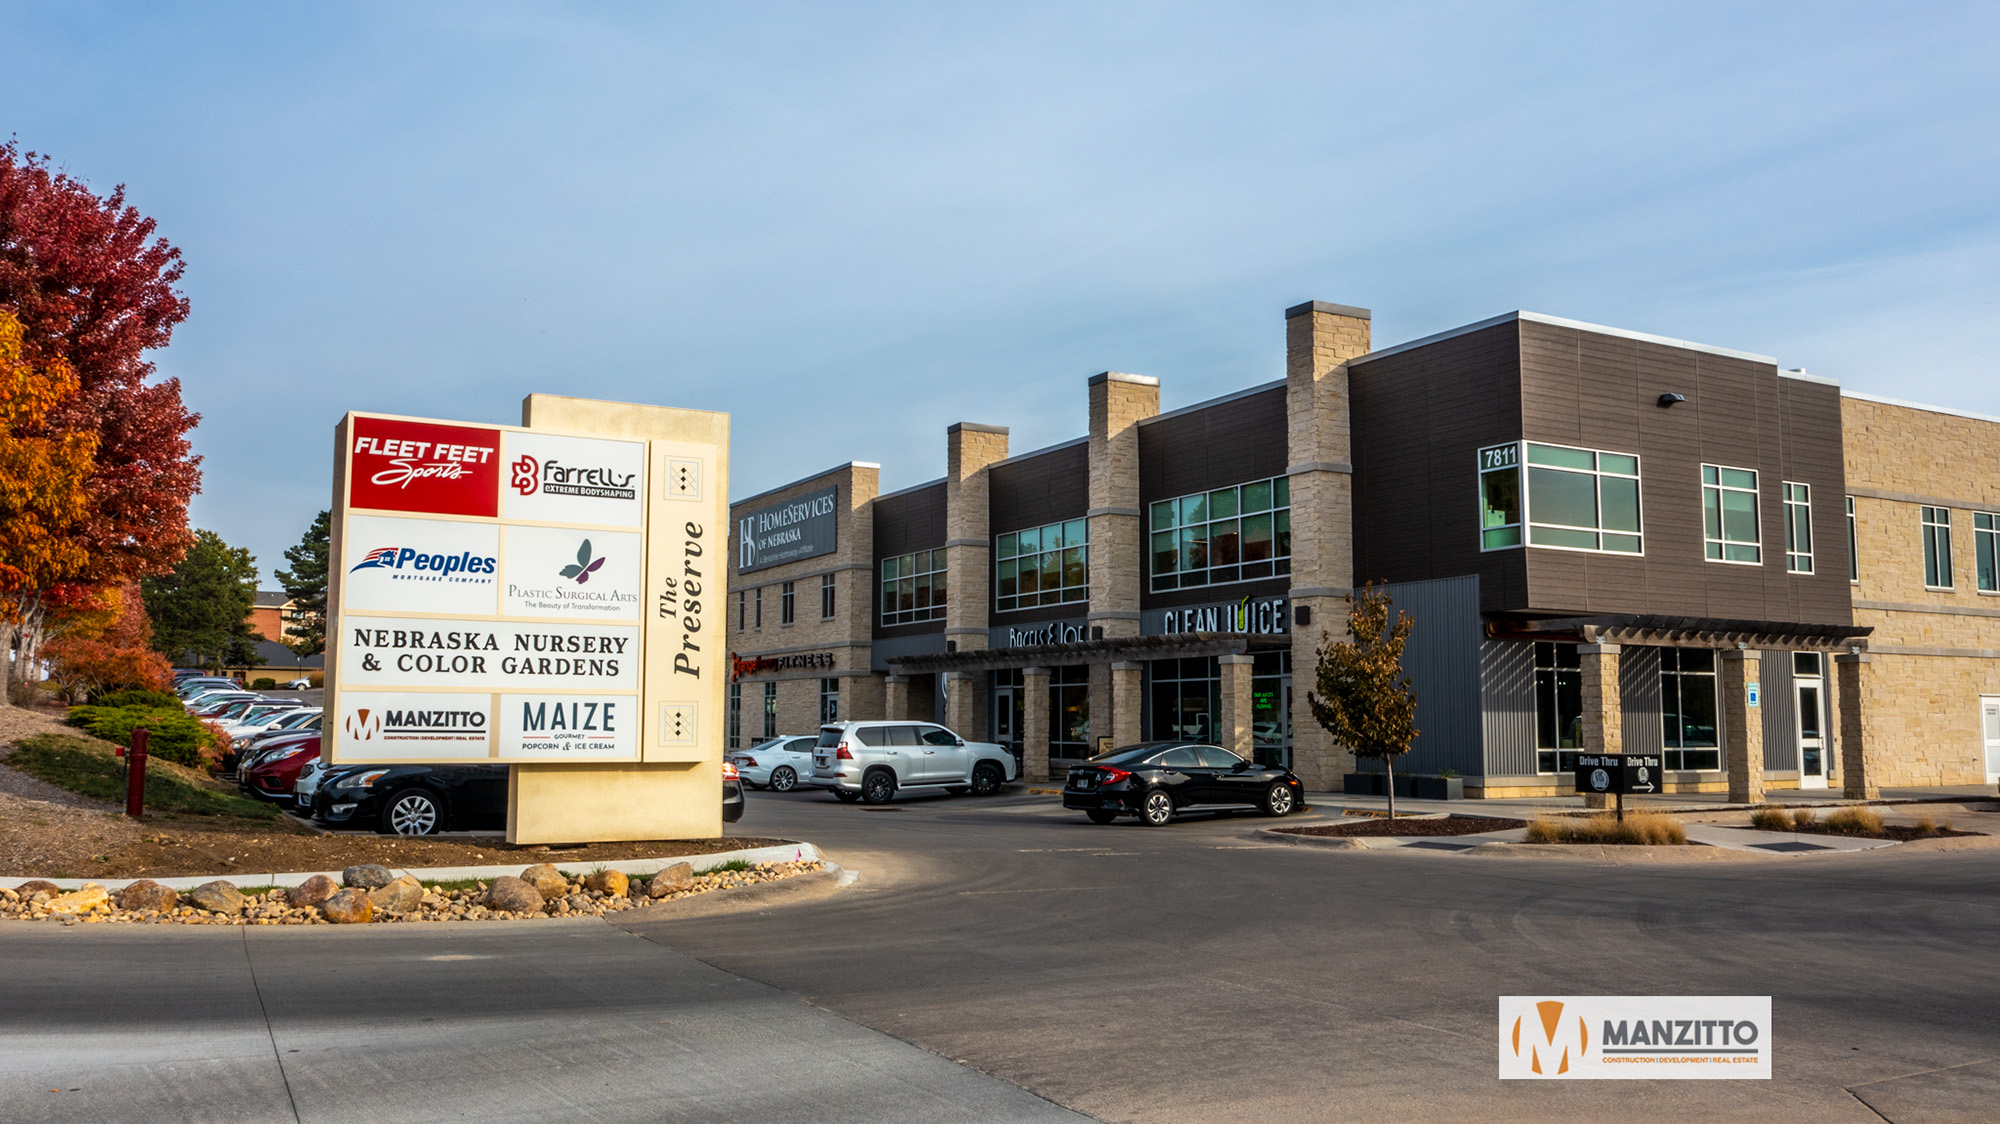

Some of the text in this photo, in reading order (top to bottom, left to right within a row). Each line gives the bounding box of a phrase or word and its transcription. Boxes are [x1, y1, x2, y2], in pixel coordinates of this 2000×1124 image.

[354, 437, 494, 463] FLEET FEET
[1485, 446, 1516, 467] 7811
[371, 458, 473, 489] Sports
[580, 487, 634, 498] BODYSHAPING
[767, 527, 802, 549] NEBRASKA
[396, 548, 497, 576] Peoples
[392, 574, 492, 584] MORTGAGE COMPANY
[538, 601, 561, 611] Beauty
[571, 603, 621, 611] Transformation
[660, 577, 678, 619] The
[674, 521, 703, 680] Preserve
[1165, 599, 1283, 635] CLEAN JUICE
[354, 629, 629, 654] NEBRASKA NURSERY
[361, 653, 620, 677] & COLOR GARDENS
[778, 653, 834, 670] FITNESS
[385, 710, 486, 727] MANZITTO
[523, 702, 616, 732] MAIZE
[562, 742, 571, 751] &
[1579, 755, 1618, 767] Drive Thru
[1627, 756, 1658, 767] Drive Thru
